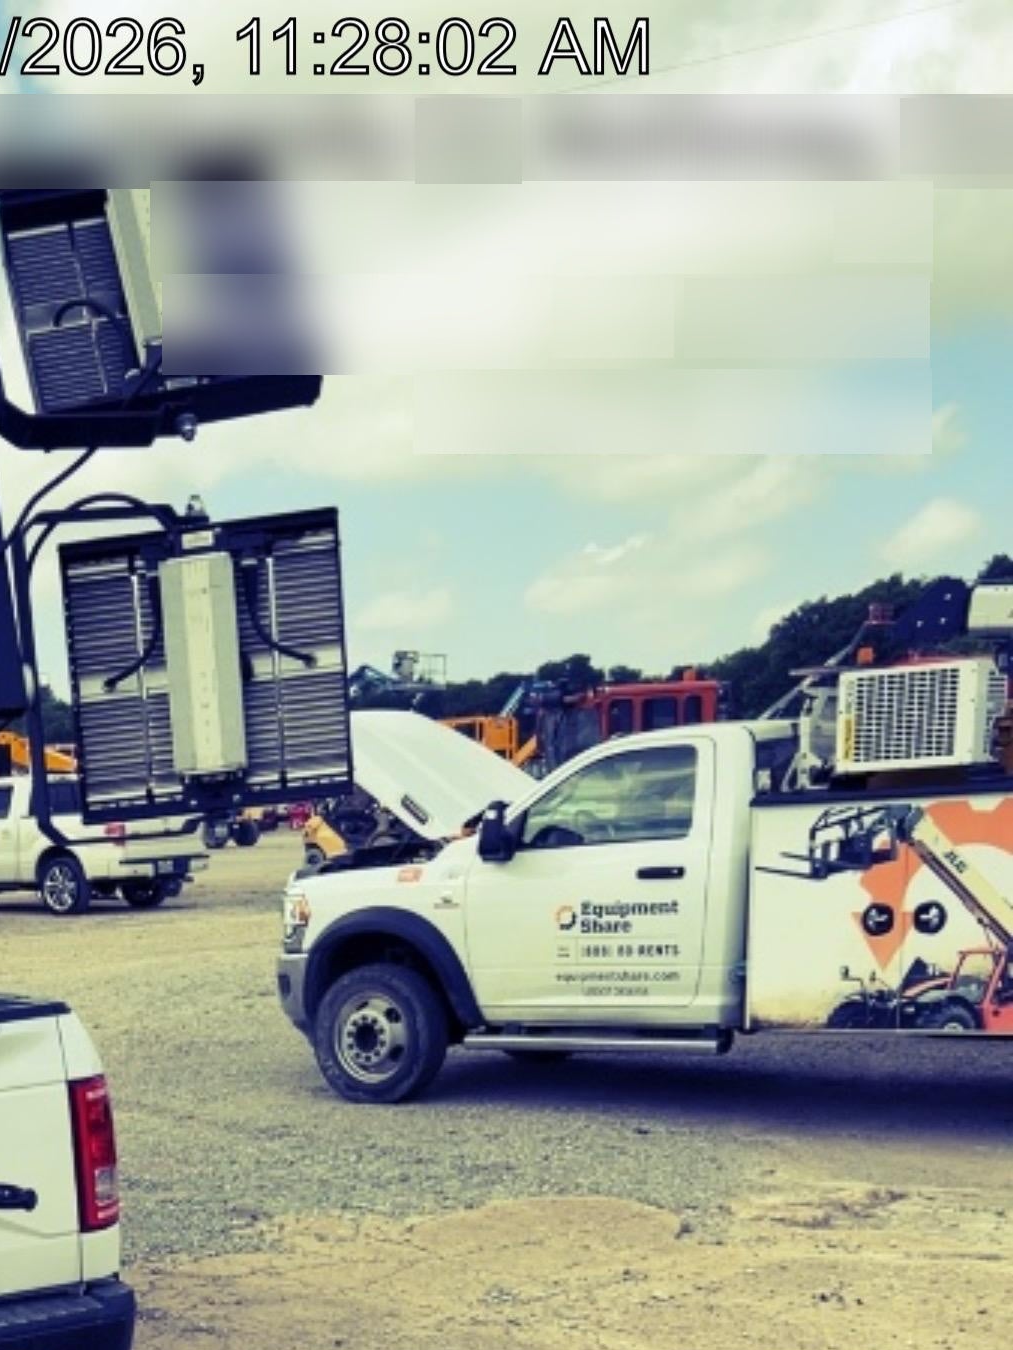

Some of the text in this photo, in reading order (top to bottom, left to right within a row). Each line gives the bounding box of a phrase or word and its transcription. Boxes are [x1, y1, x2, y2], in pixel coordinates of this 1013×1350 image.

[580, 900, 680, 918] Equipment
[580, 918, 633, 934] Share
[555, 970, 680, 984] equipmentshare.com
